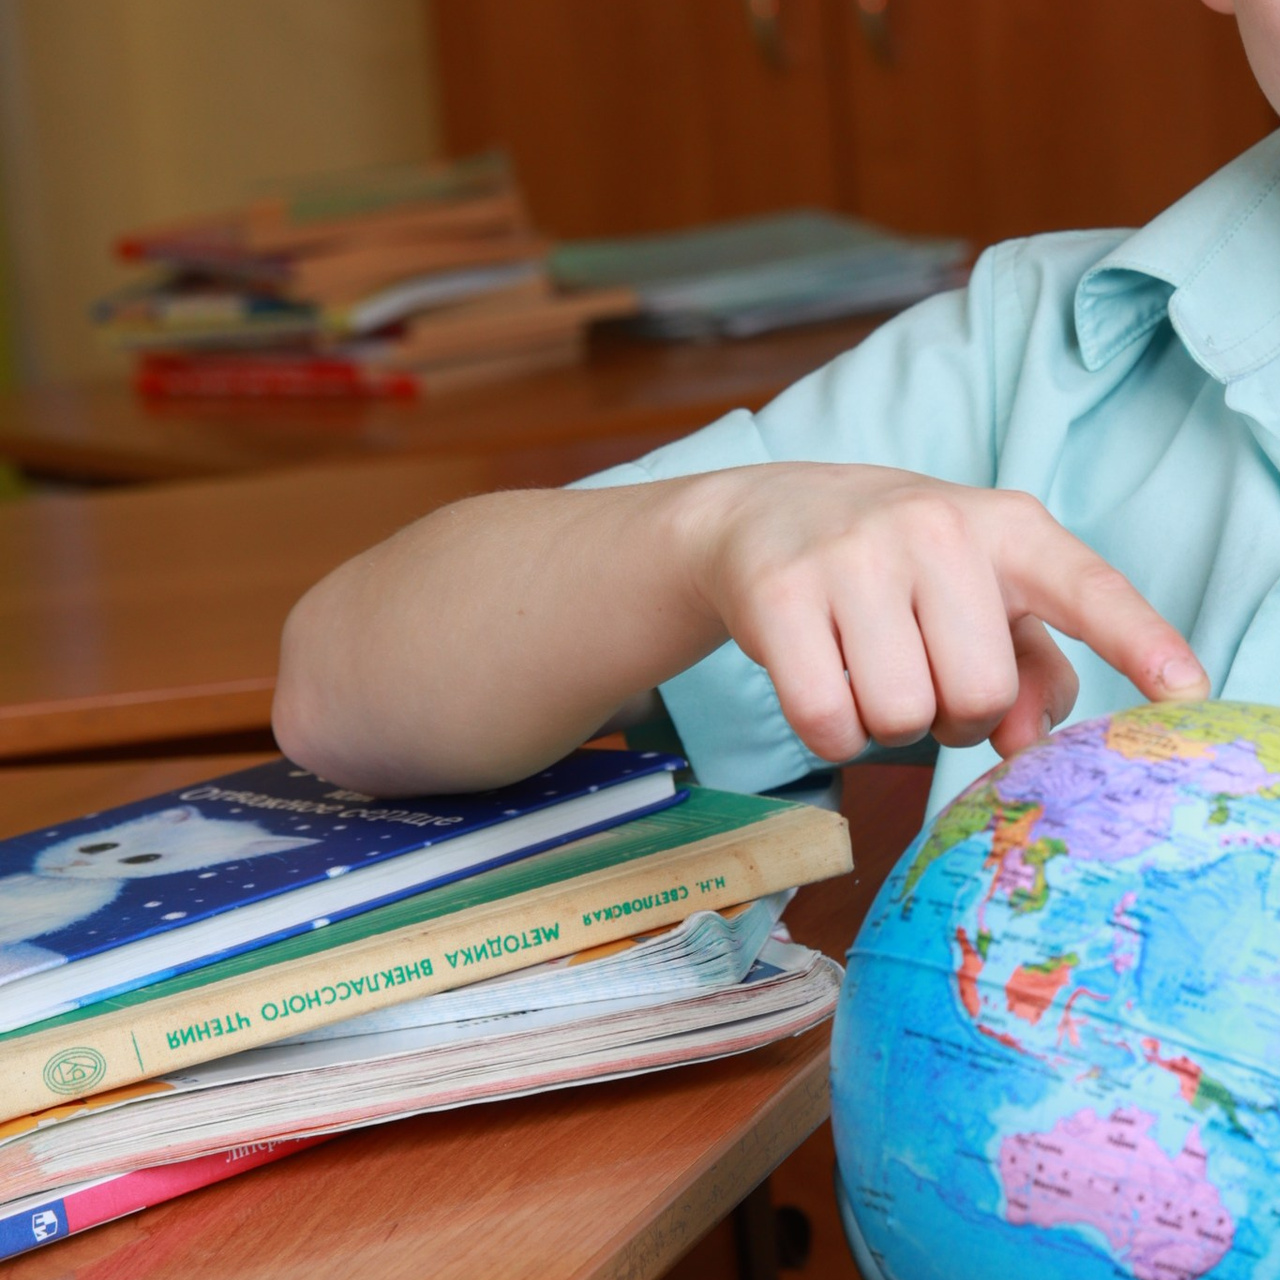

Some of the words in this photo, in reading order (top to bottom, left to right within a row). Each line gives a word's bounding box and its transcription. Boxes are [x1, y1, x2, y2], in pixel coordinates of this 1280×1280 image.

[179, 785, 345, 814] Отважное
[338, 807, 464, 827] сердце
[696, 875, 726, 894] Н.Н.
[582, 885, 689, 926] СВЕТЛОВСКАЯ
[444, 922, 561, 969] МЕТОДИКА
[261, 957, 434, 1021] ВНЕКЛАССНОГО
[166, 1013, 251, 1050] ЧТЕНИЯ
